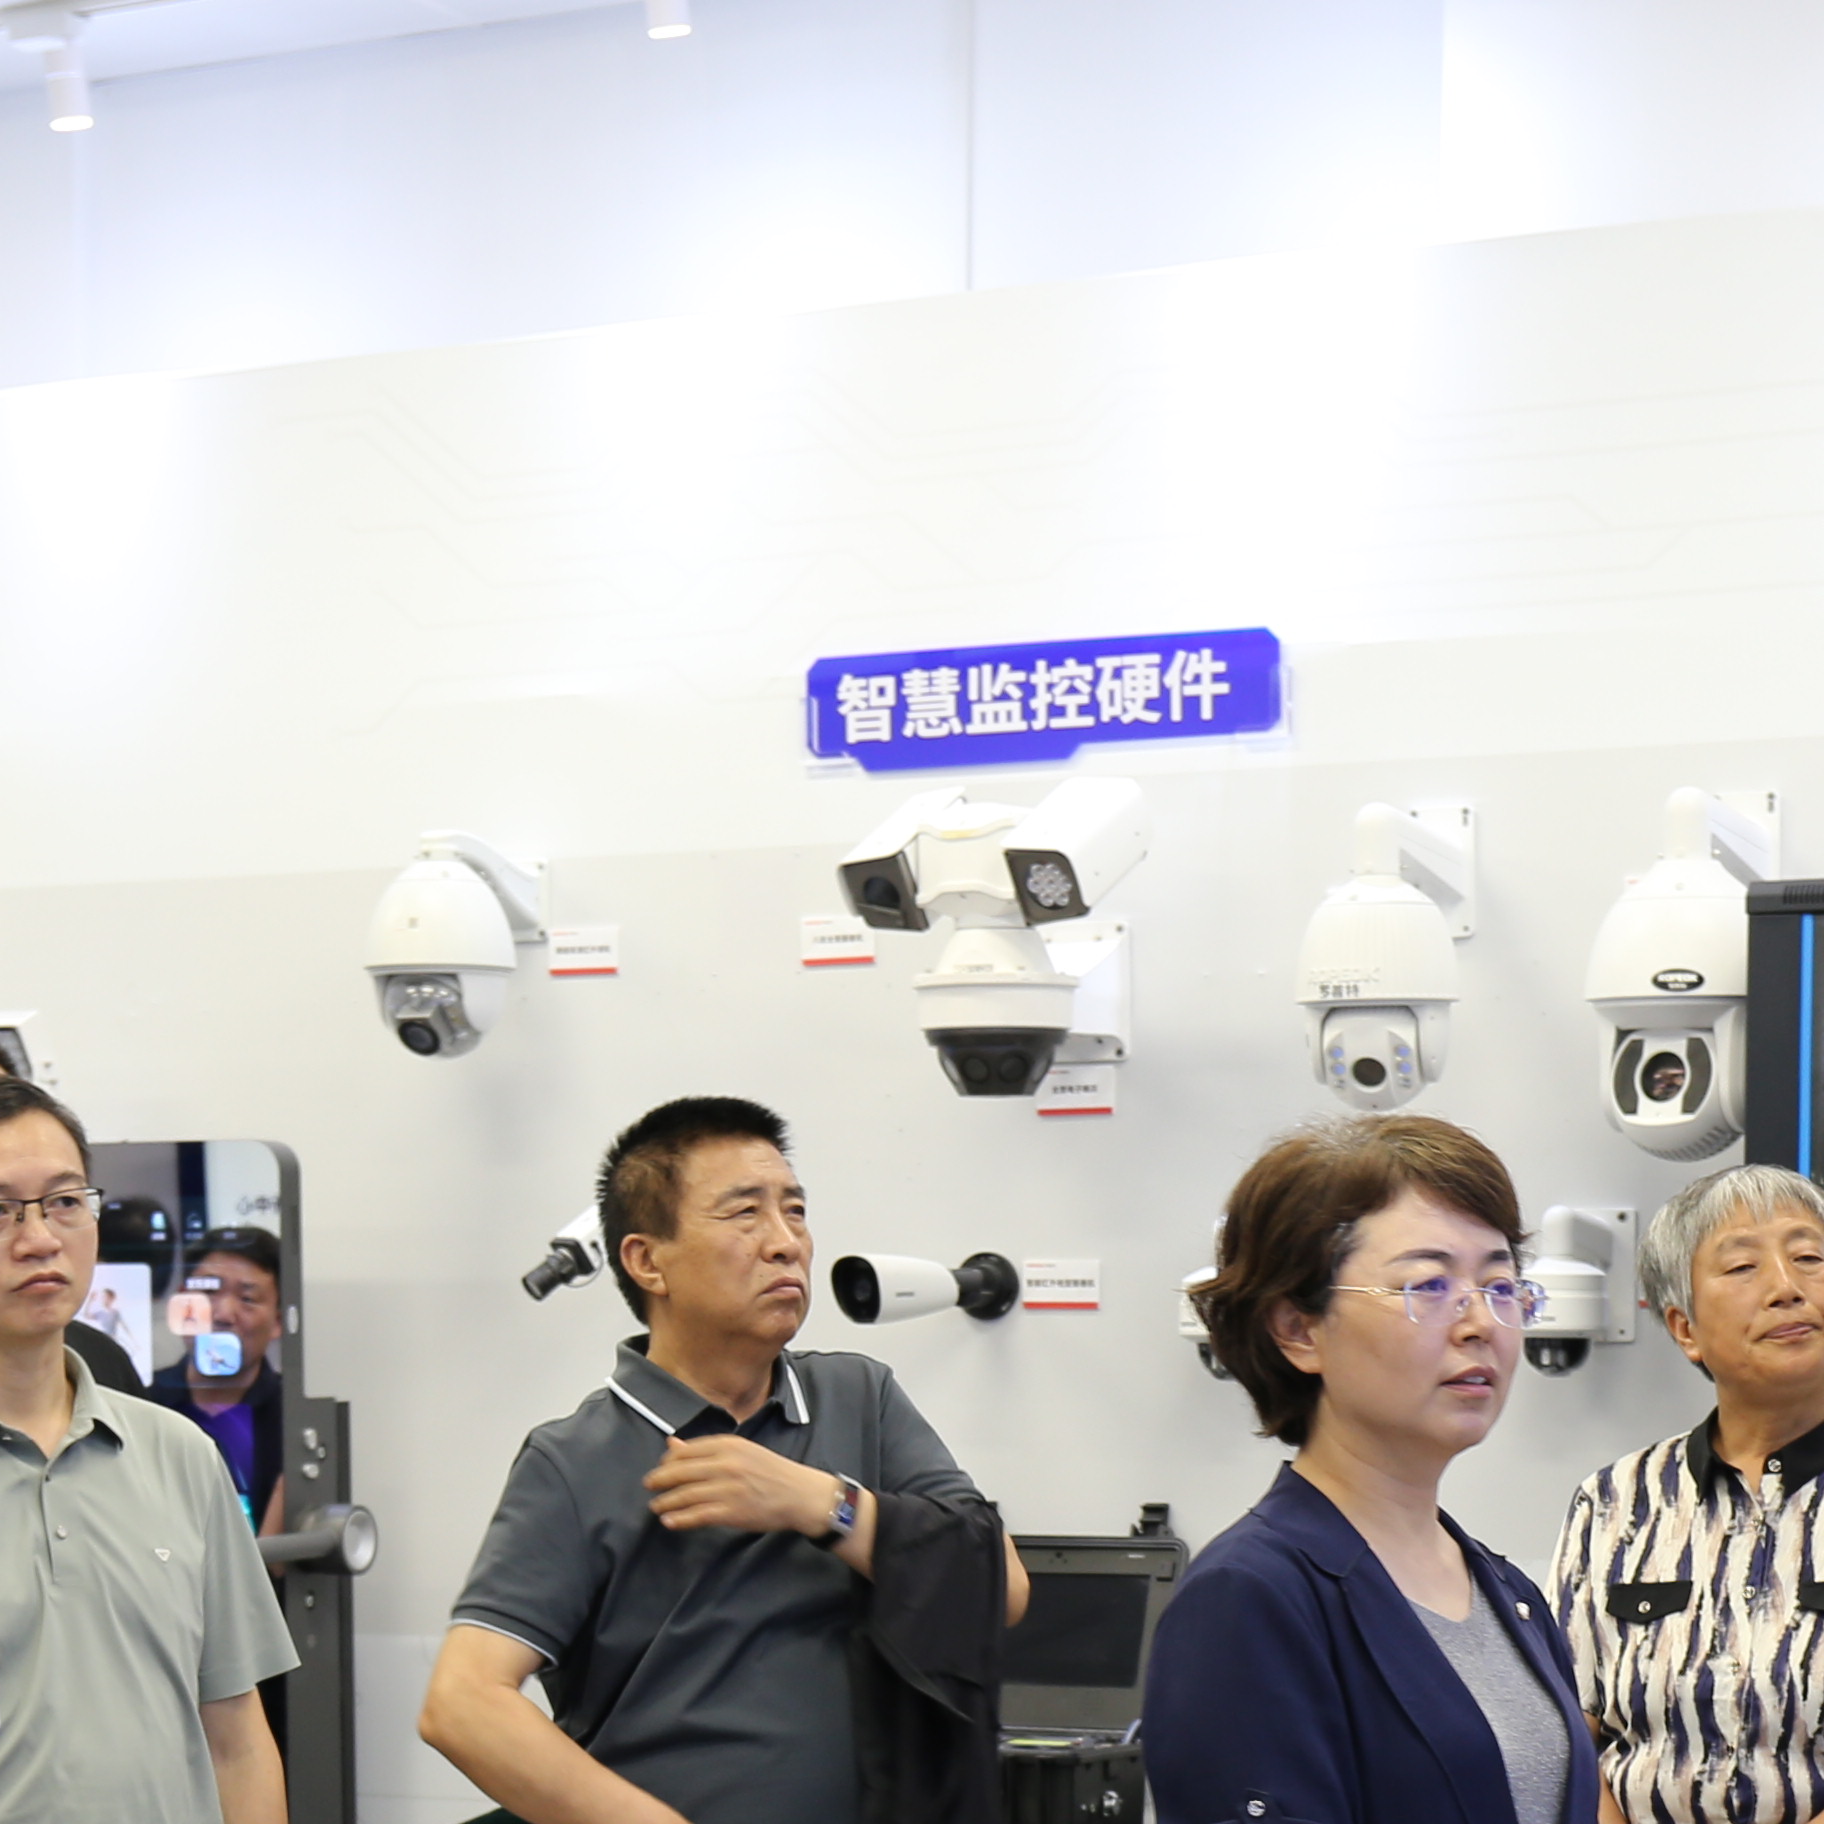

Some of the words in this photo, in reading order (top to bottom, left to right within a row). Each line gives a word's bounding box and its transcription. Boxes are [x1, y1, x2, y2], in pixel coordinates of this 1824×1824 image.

[837, 648, 1231, 744] 智慧监控硬件
